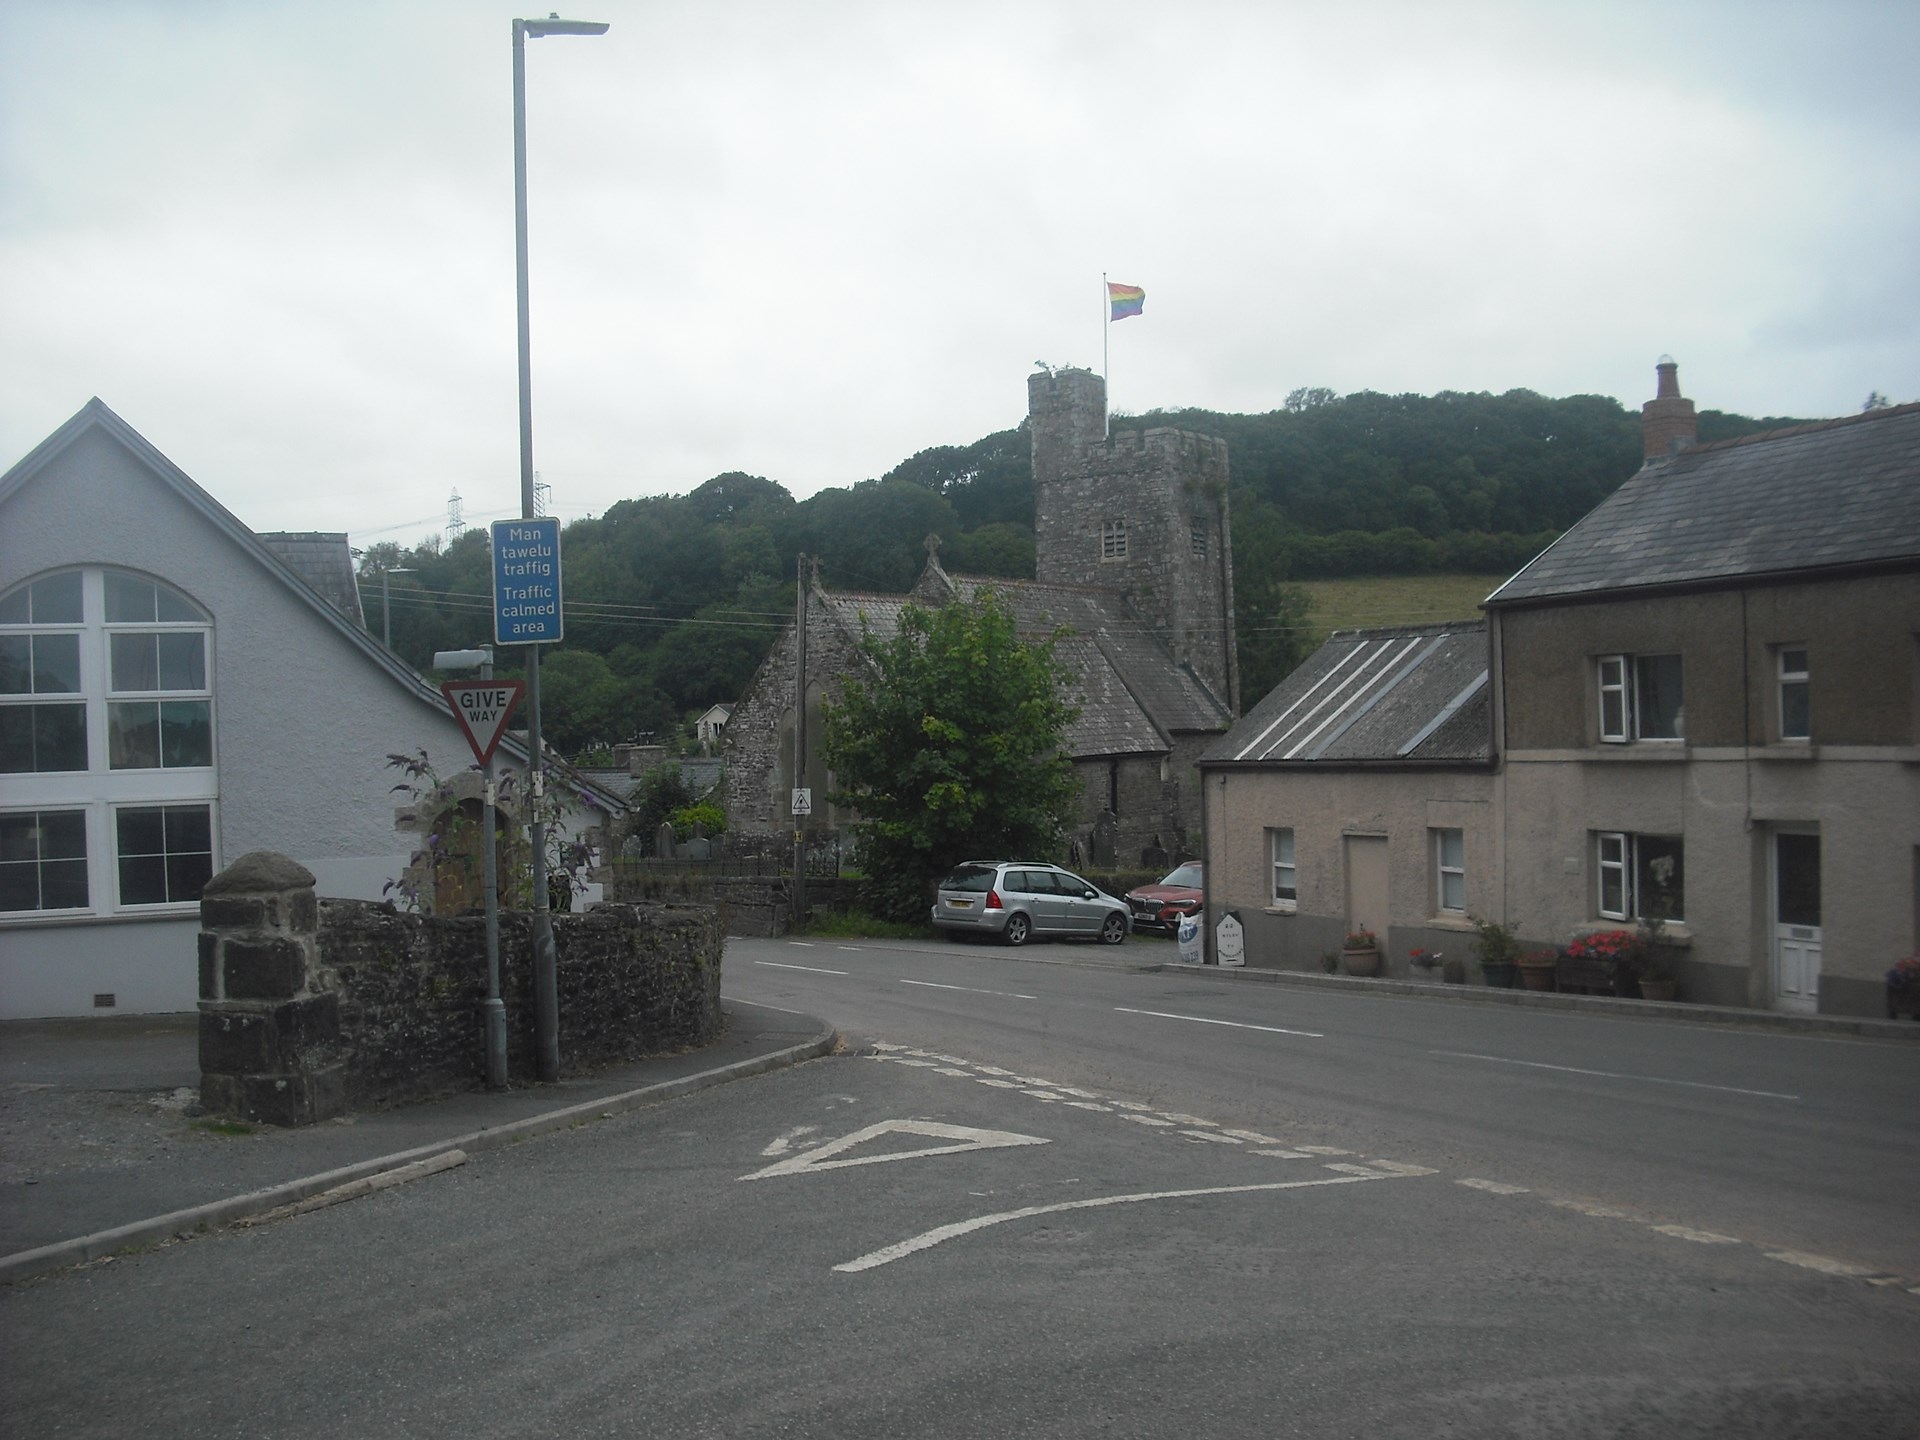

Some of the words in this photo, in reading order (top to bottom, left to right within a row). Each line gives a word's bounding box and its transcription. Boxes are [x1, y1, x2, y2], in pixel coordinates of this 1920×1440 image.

[509, 528, 541, 541] Man
[502, 544, 551, 559] tawelu
[504, 561, 551, 576] traffig
[504, 585, 552, 600] Traffic
[502, 602, 555, 617] calmed
[513, 622, 545, 633] area
[461, 691, 507, 708] GIVE
[470, 711, 498, 722] WAY
